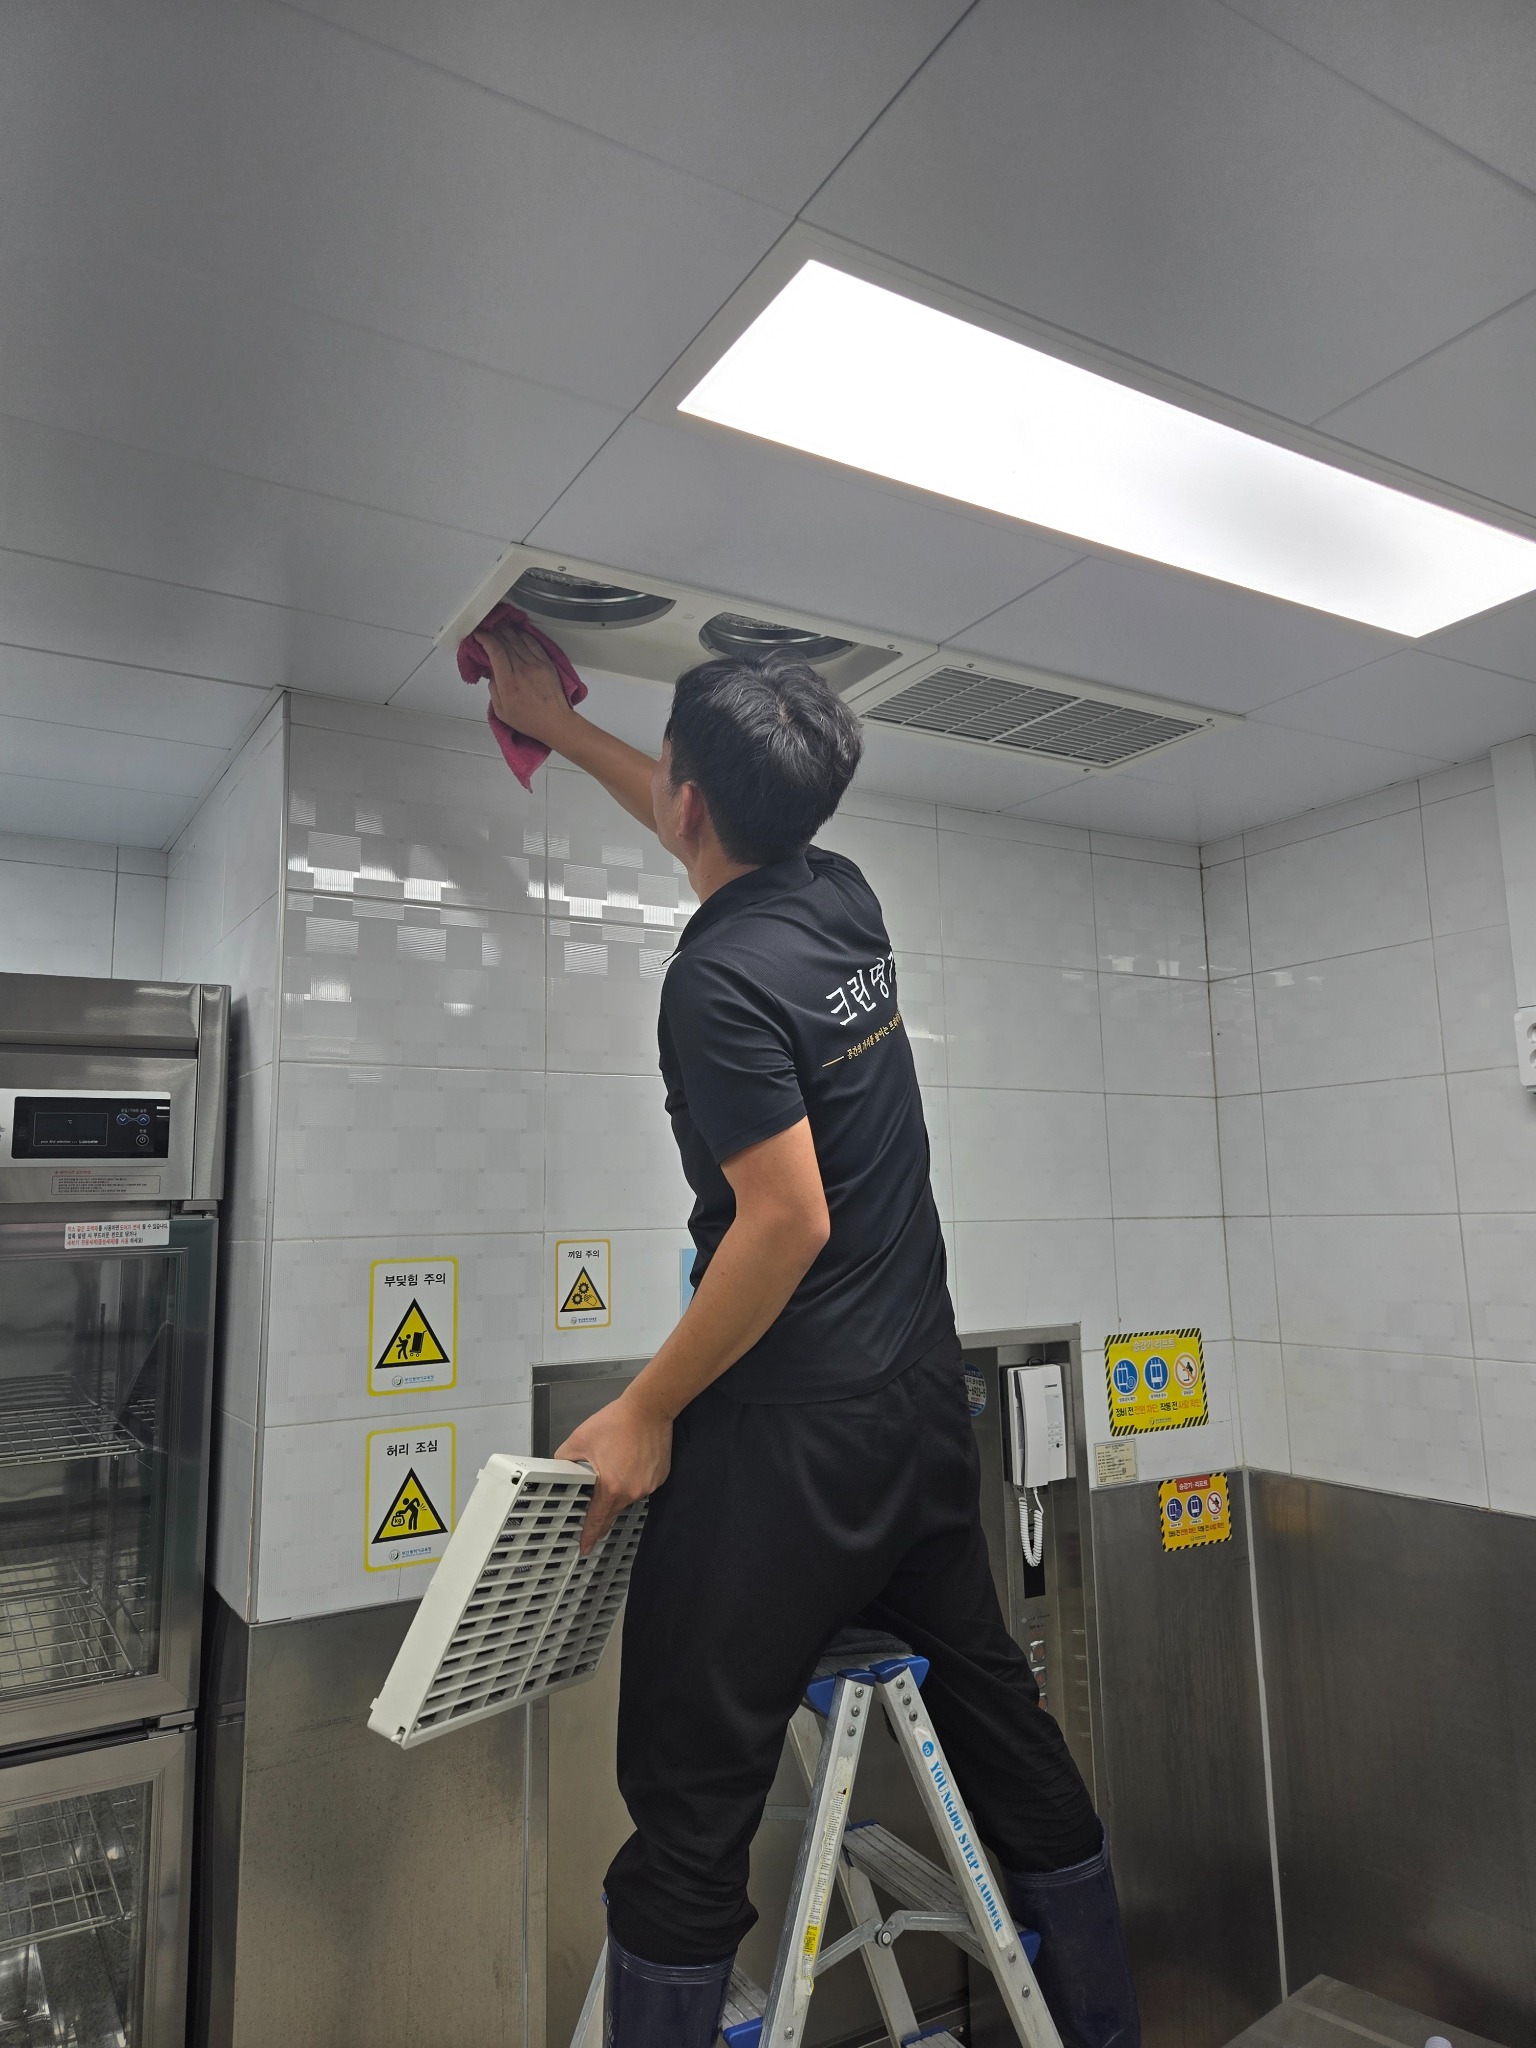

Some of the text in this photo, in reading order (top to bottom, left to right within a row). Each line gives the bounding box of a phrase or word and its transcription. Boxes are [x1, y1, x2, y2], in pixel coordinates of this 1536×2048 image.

[585, 1250, 600, 1258] 주의
[384, 1272, 446, 1288] 부딪힘 주의
[1115, 1408, 1128, 1418] 정비
[1127, 1406, 1134, 1416] 전
[1160, 1402, 1171, 1412] 작동
[1171, 1401, 1178, 1411] 전
[386, 1439, 438, 1457] 허리 조심
[929, 1760, 1004, 1934] YOUNGDO STEP LADDER
